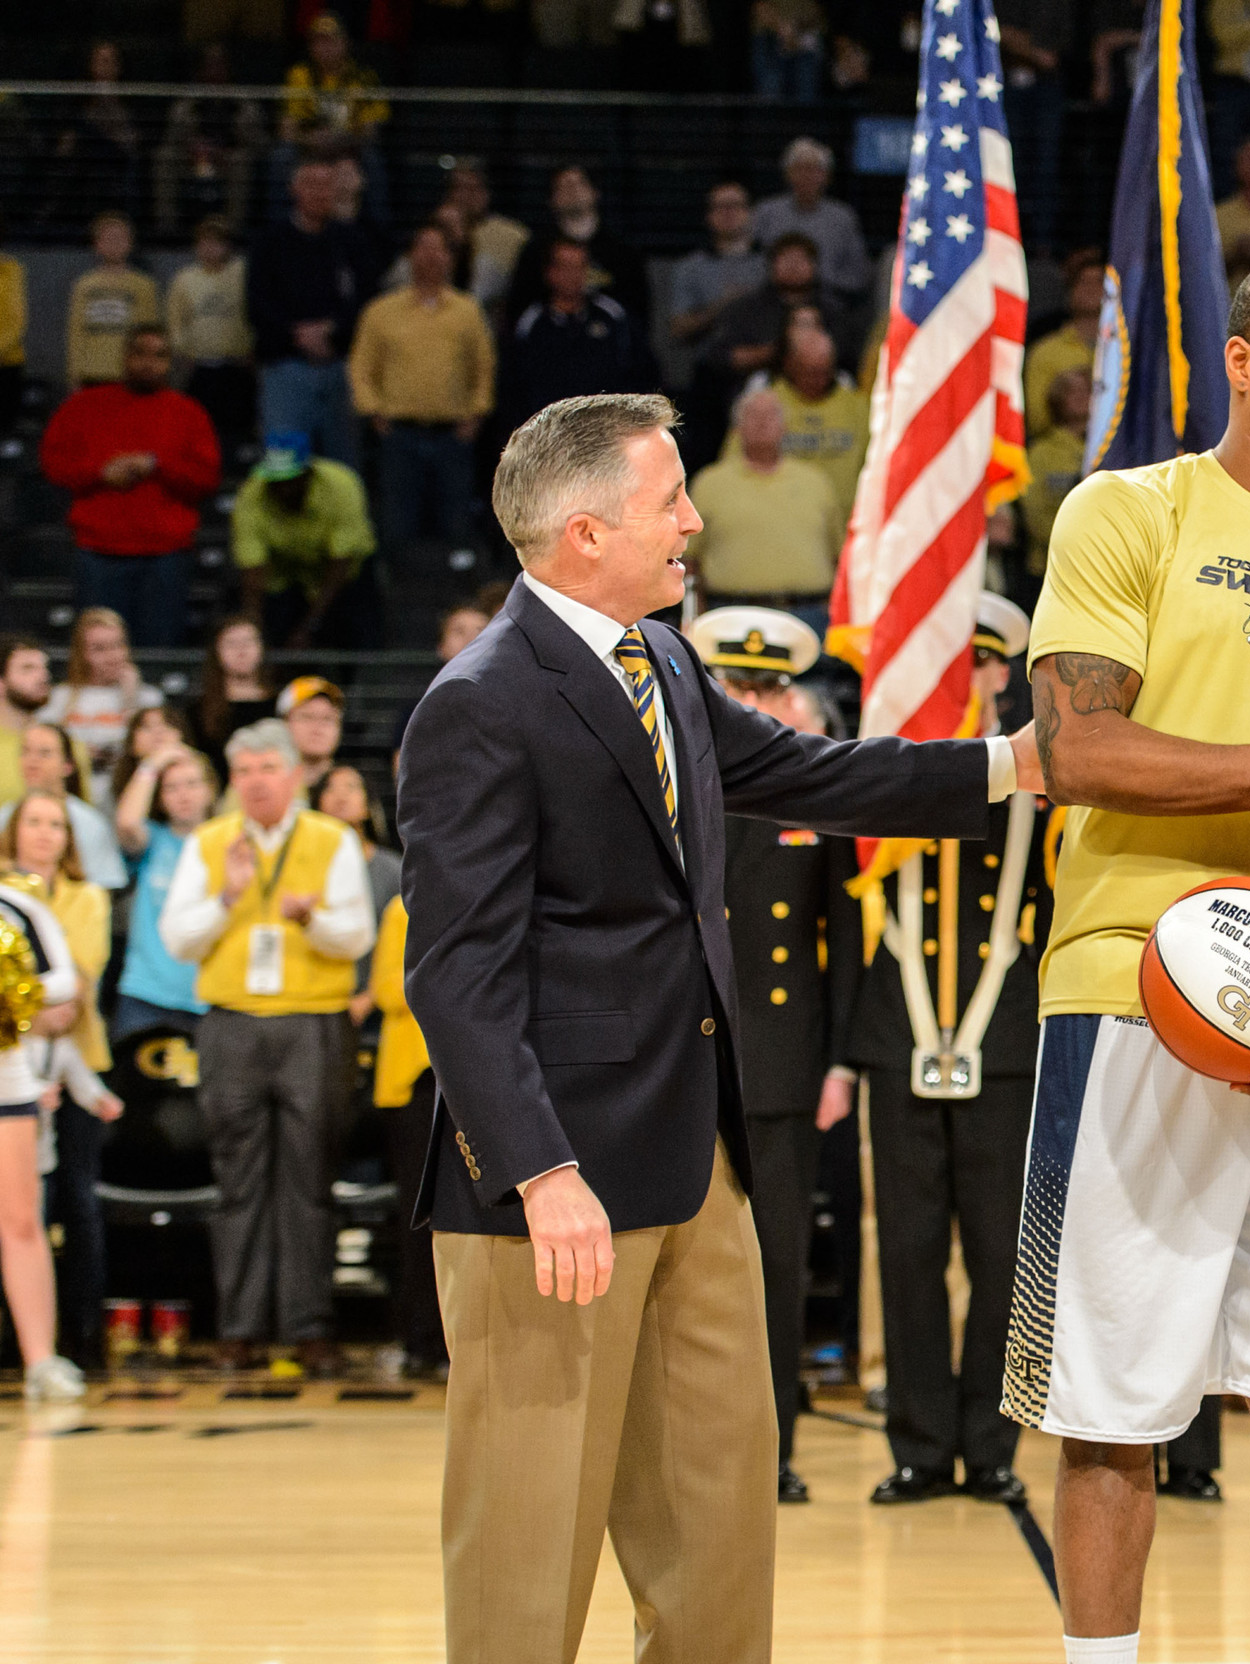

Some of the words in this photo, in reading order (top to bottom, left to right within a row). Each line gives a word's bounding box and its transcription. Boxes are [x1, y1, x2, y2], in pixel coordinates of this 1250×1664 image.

[1211, 917, 1244, 942] 1,000
[1210, 942, 1242, 966] GEORGIA
[1007, 1338, 1044, 1384] GT
